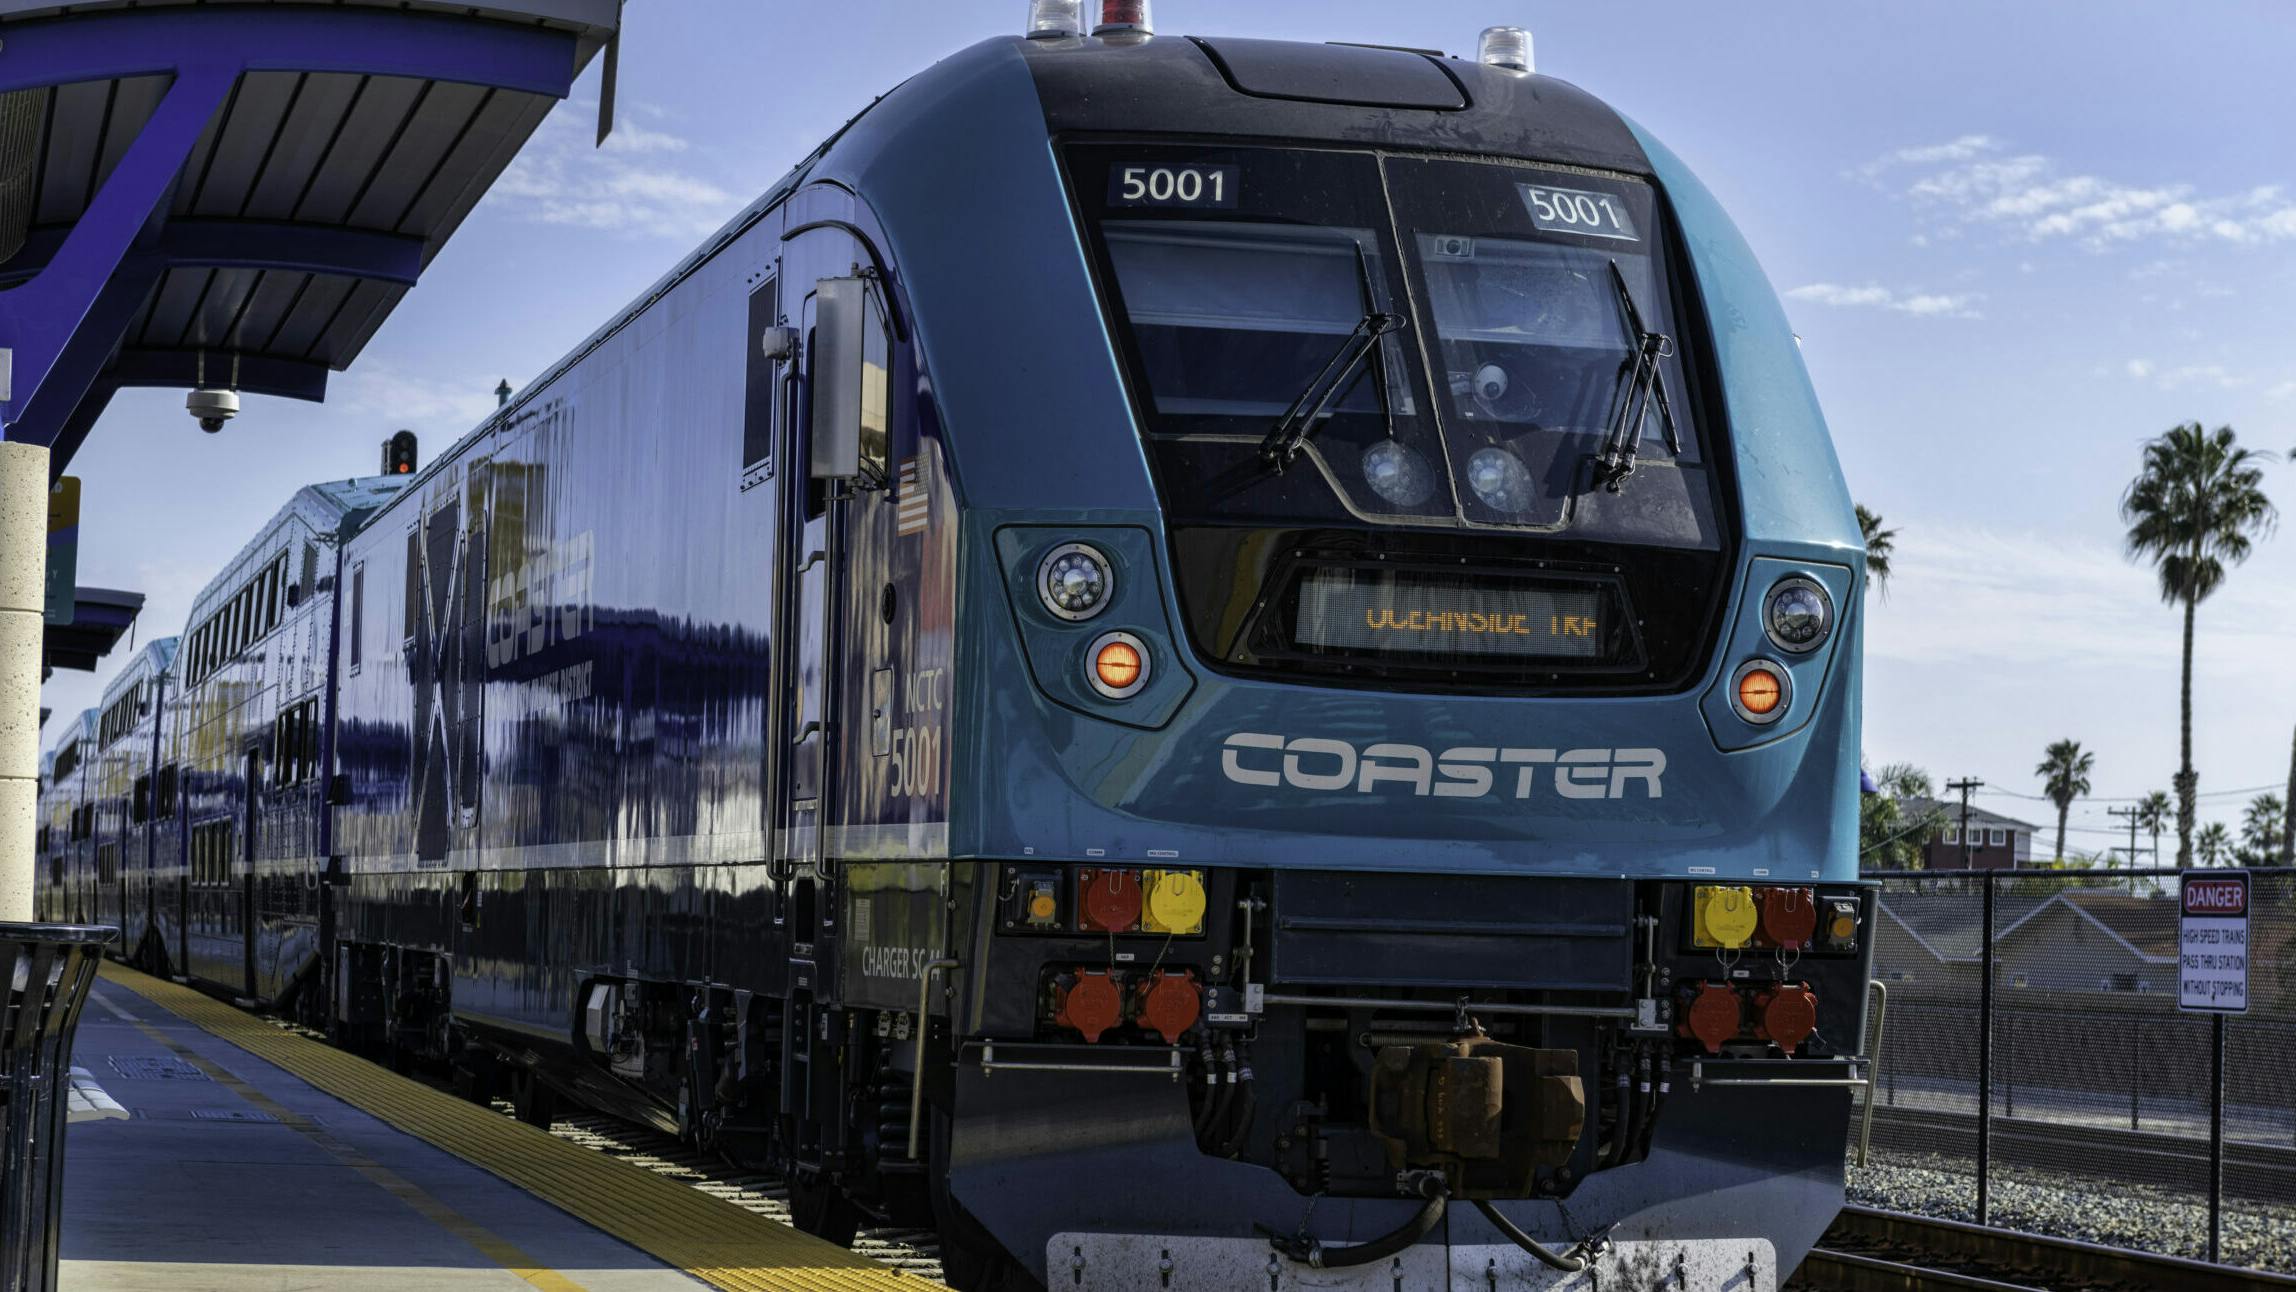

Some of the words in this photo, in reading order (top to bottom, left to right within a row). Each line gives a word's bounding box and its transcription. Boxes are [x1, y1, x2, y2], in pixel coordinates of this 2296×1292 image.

[1122, 167, 1223, 202] 5001
[1528, 187, 1620, 229] 5001
[906, 667, 943, 714] NCTC
[891, 725, 941, 797] 5001
[1221, 732, 1668, 799] COASTER
[2187, 886, 2242, 907] DANGER
[2183, 929, 2198, 944] HIGH
[2200, 929, 2220, 944] SPEED
[2221, 929, 2244, 944] TRAINS
[862, 946, 909, 978] CHARGER
[2182, 954, 2199, 969] PASS
[2200, 954, 2217, 969] THRU
[2218, 955, 2244, 970] STATION
[2183, 980, 2211, 995] WITHOUT
[2212, 980, 2243, 996] STOPPING
